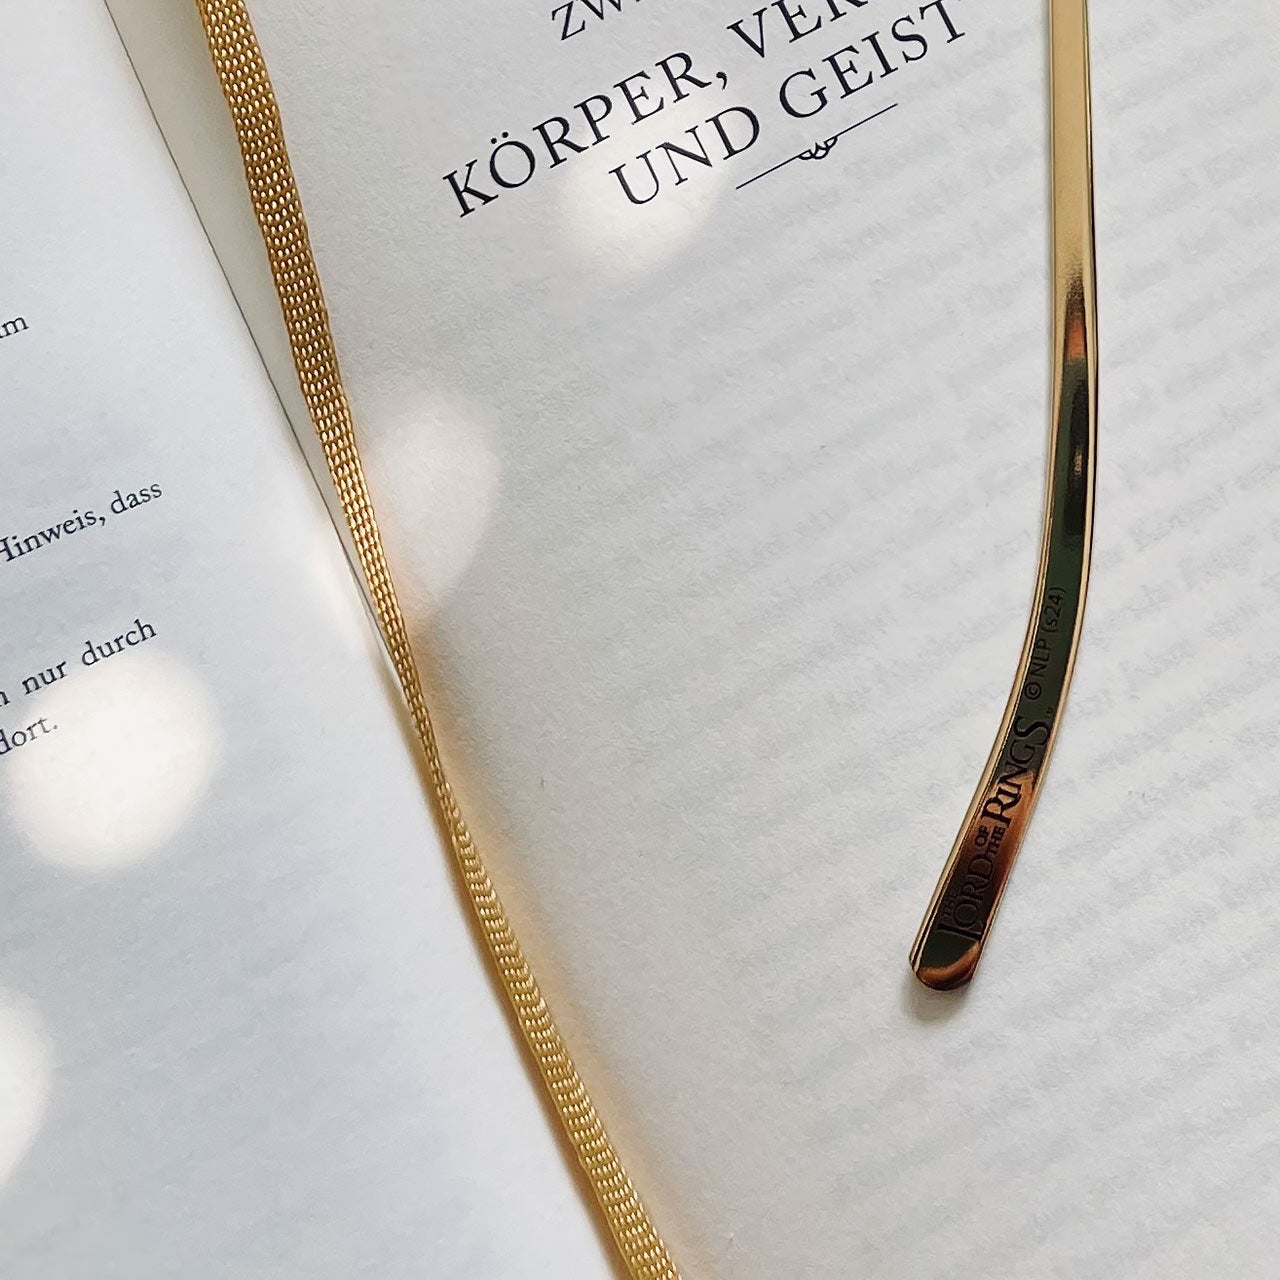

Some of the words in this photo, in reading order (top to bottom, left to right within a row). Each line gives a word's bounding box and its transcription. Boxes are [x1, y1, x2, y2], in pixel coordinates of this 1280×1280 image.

[442, 50, 728, 218] KÖRPER,
[609, 105, 760, 206] UND
[110, 483, 163, 514] dass
[21, 661, 68, 695] nur
[81, 618, 157, 666] durch
[974, 825, 990, 847] OF
[987, 826, 1006, 856] THE
